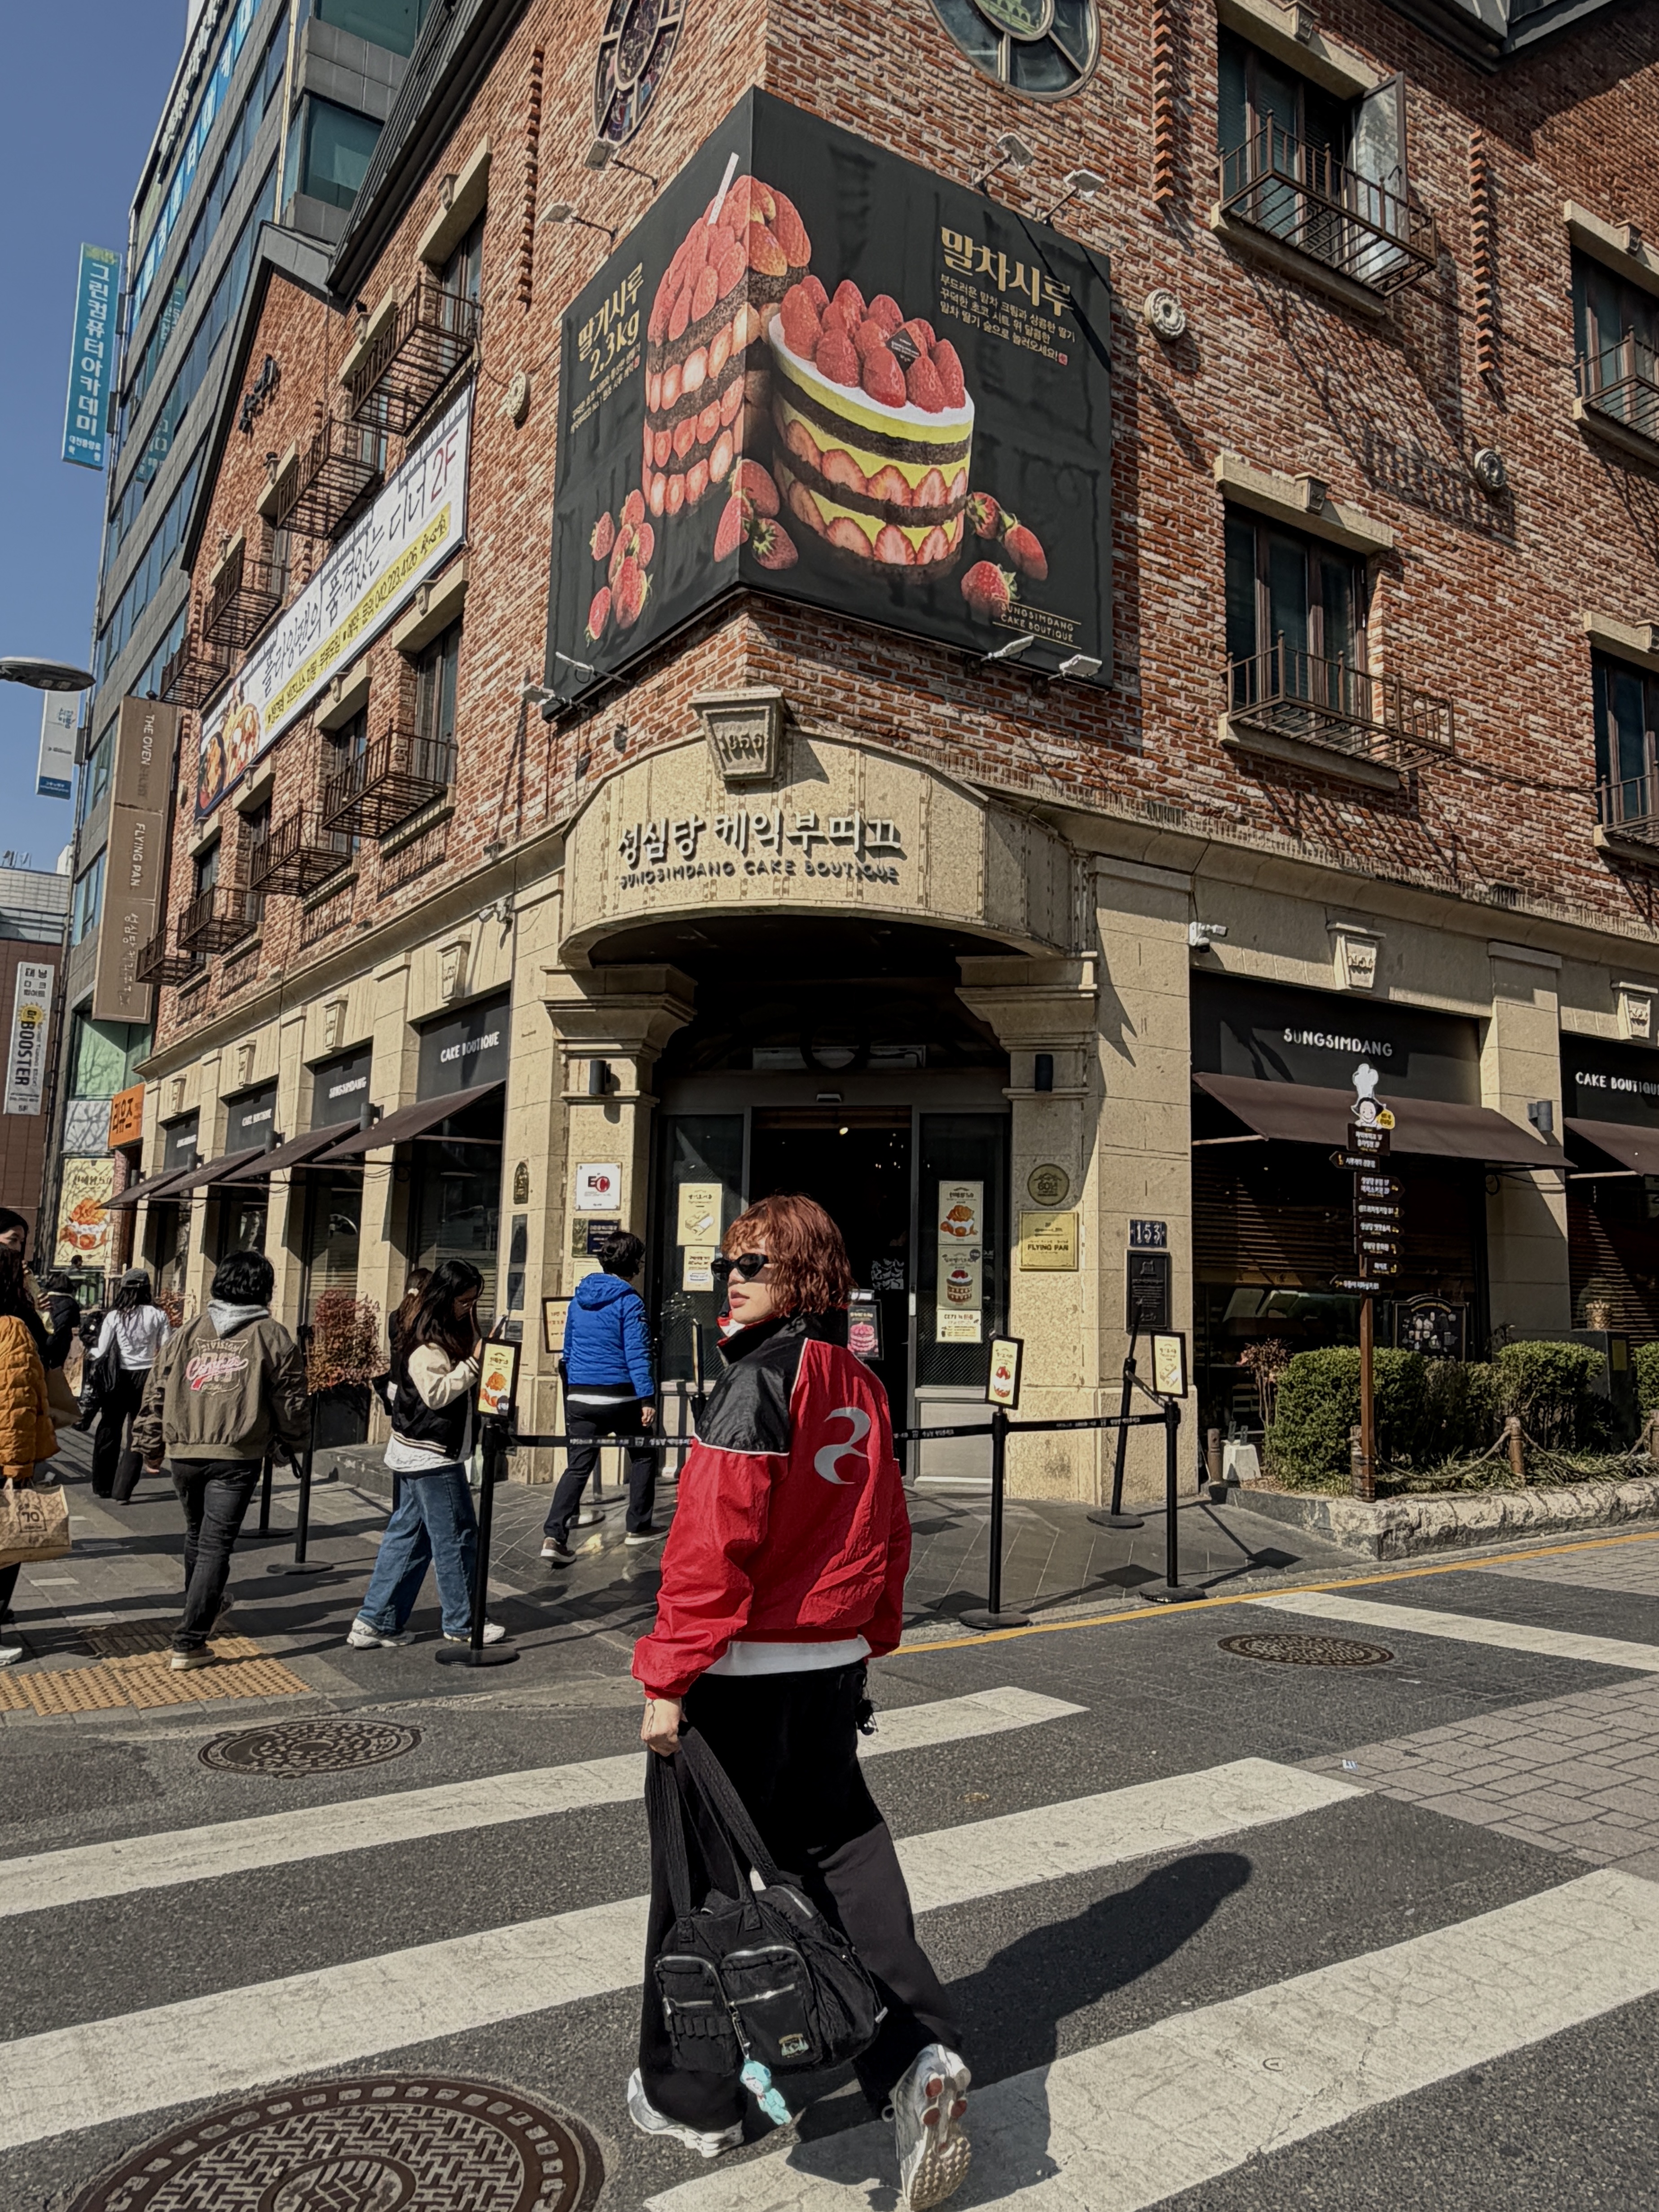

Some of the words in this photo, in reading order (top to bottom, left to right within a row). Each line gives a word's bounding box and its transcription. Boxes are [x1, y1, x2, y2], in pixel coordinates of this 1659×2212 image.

[941, 226, 1074, 317] 말차시루
[578, 262, 644, 362] 딸기시루
[940, 273, 977, 300] 부드러운
[980, 291, 998, 308] 말차
[1058, 326, 1076, 343] 딸기
[940, 300, 959, 318] 말차
[76, 262, 110, 436] 그린컴퓨터아카데미
[589, 309, 640, 381] 2.3kg
[262, 584, 323, 699] 플라잉팬의
[325, 524, 385, 628] 품격있는
[389, 459, 426, 541] 디너
[430, 428, 458, 503] 2F
[1001, 603, 1074, 632] SUNGSIMDANG
[1001, 613, 1025, 628] CAKE
[1028, 622, 1074, 643] BOUTIQUE
[143, 714, 155, 735] THE
[141, 736, 153, 765] OVEN
[132, 822, 145, 861] FLYING
[620, 813, 704, 865] 성심당
[714, 808, 902, 853] 케익부띠끄
[130, 864, 142, 887] PAN
[620, 859, 736, 890] SUNGSIMDANG
[744, 859, 796, 878] CAKE
[804, 859, 901, 886] BOUTIQUE
[122, 912, 139, 947] 성심당
[14, 1020, 36, 1086] BOOSTER
[440, 1044, 460, 1063] CAKE
[462, 1031, 500, 1056] BOUTIQUE
[1283, 1027, 1393, 1057] SUNGSIMDANG
[1575, 1071, 1607, 1088] CAKE
[1136, 1221, 1161, 1244] 153
[22, 1511, 40, 1522] 70
